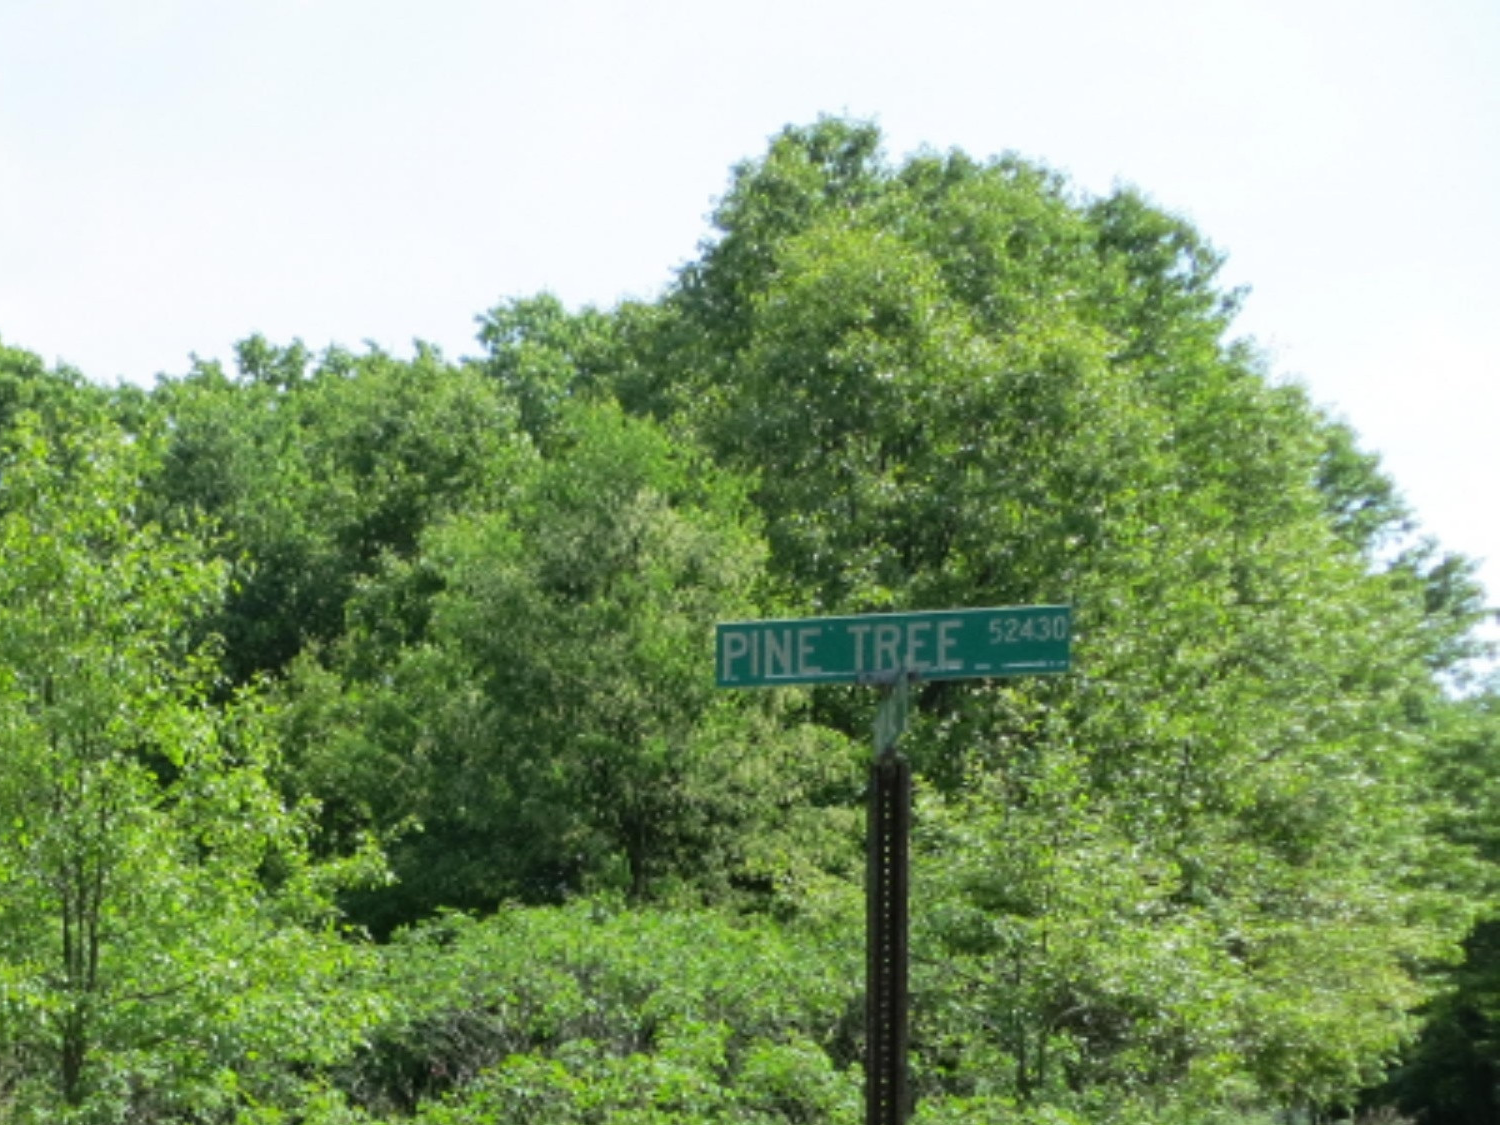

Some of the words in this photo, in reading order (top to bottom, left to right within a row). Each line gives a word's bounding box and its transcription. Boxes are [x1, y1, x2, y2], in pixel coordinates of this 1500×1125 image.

[723, 627, 822, 681] PINE
[847, 620, 964, 673] TREE
[988, 615, 1066, 644] 52430
